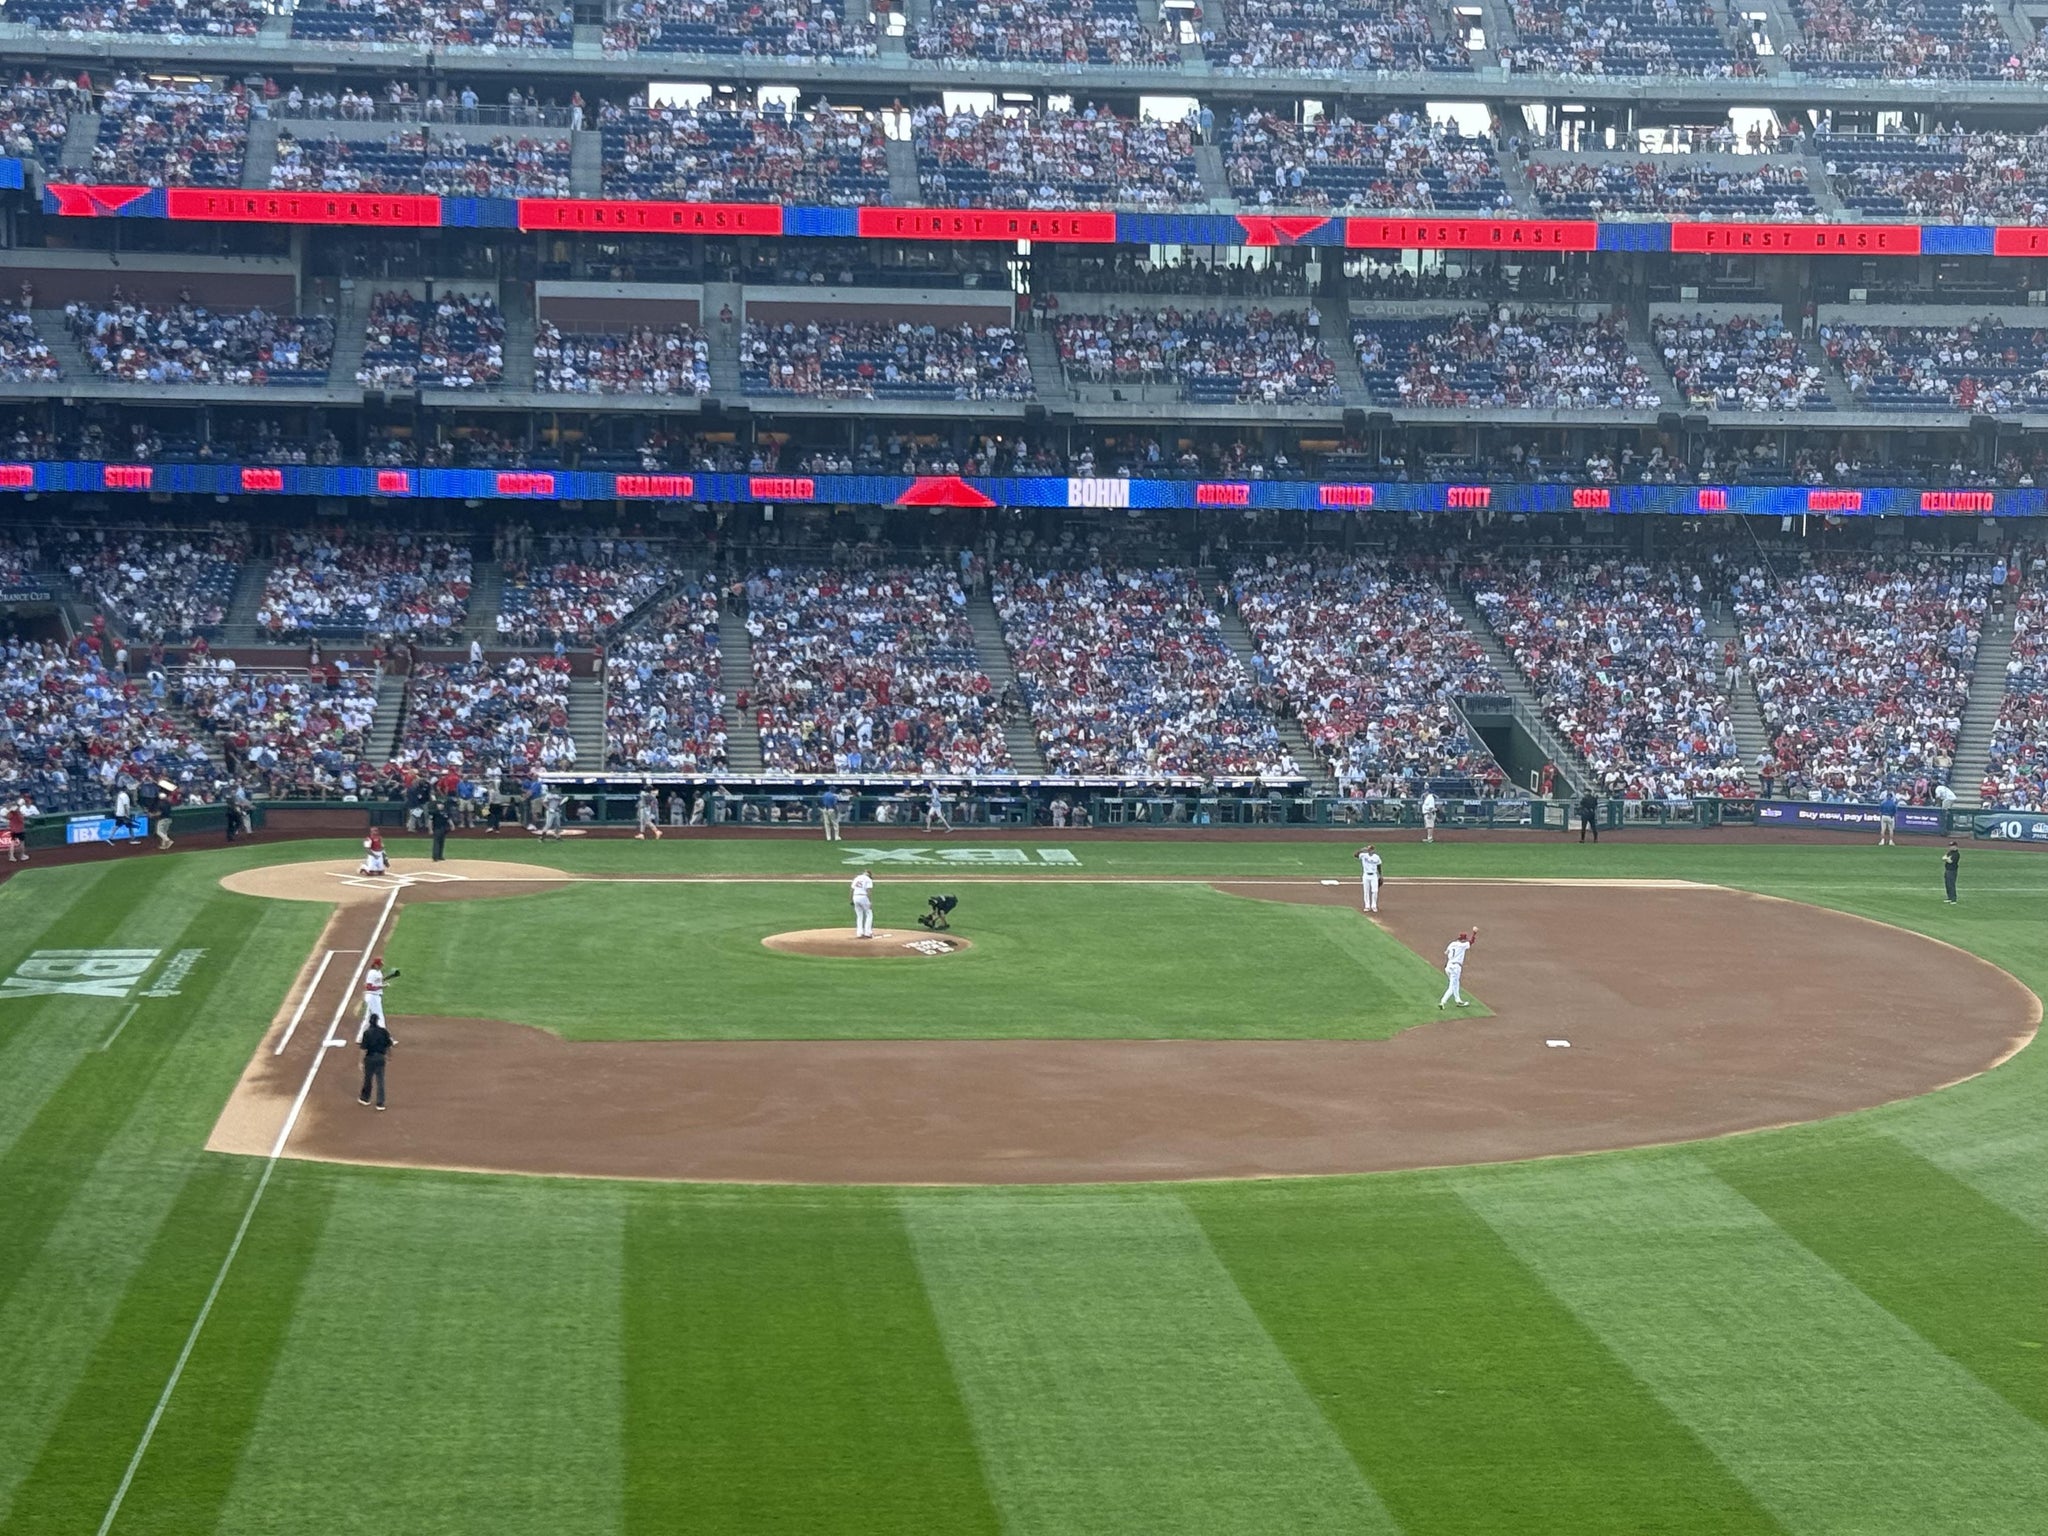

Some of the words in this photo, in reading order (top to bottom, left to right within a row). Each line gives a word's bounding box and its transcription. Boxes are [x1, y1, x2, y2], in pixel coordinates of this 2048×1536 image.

[207, 198, 300, 215] FIRST
[326, 200, 402, 218] BASE
[557, 208, 647, 225] FIRST
[673, 210, 745, 227] BASE
[895, 216, 983, 233] FIRST
[1008, 218, 1081, 235] BASE
[1381, 225, 1468, 242] FIRST
[1492, 227, 1562, 244] BASE
[1706, 230, 1792, 246] FIRST
[1816, 232, 1887, 248] BASE
[1363, 305, 1445, 316] CADILLAC
[1559, 305, 1599, 318] CLUB
[616, 475, 694, 497] REALMUTO
[750, 477, 815, 498] WHEELER
[1067, 478, 1130, 508] BOHM
[1319, 486, 1373, 506] TURNER
[1447, 487, 1491, 508] STOTT
[1573, 489, 1611, 508] SOSA
[1921, 491, 1994, 511] REALMUTO
[1844, 814, 1863, 822] pay
[73, 827, 100, 843] IBX
[2000, 821, 2023, 839] 10
